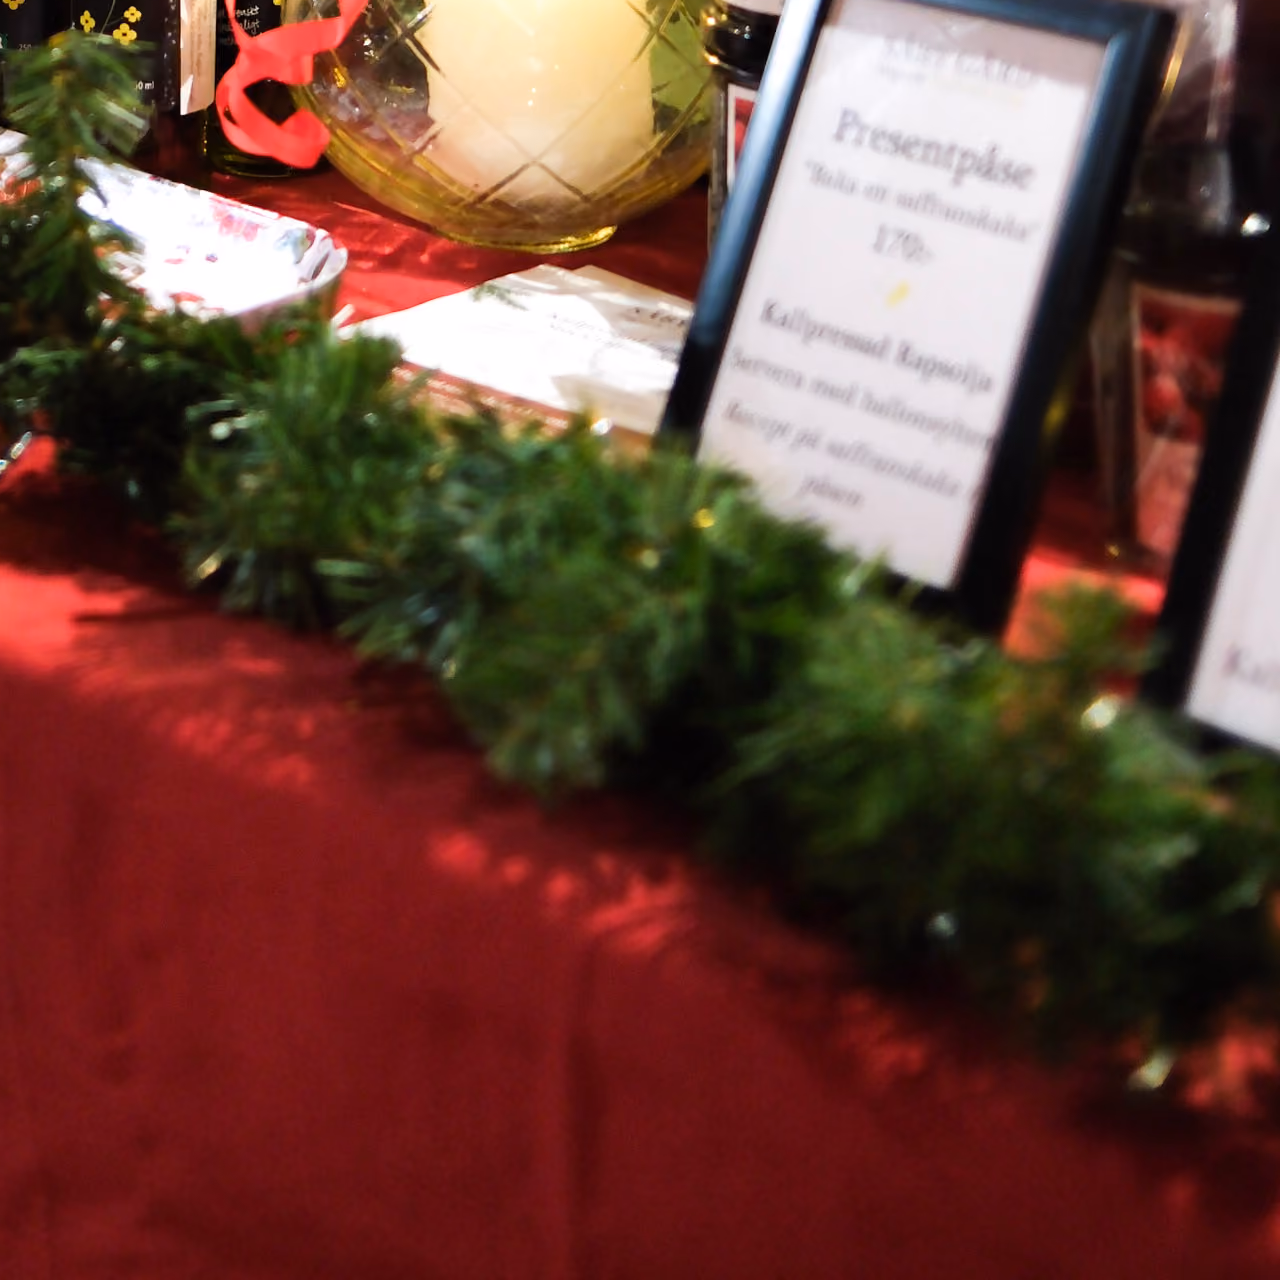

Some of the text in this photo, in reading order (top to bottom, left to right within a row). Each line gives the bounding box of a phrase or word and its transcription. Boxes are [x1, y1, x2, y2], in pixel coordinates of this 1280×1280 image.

[833, 105, 1037, 192] Presentpåse
[759, 297, 893, 361] Kallpressad
[894, 339, 995, 395] Rapsolja
